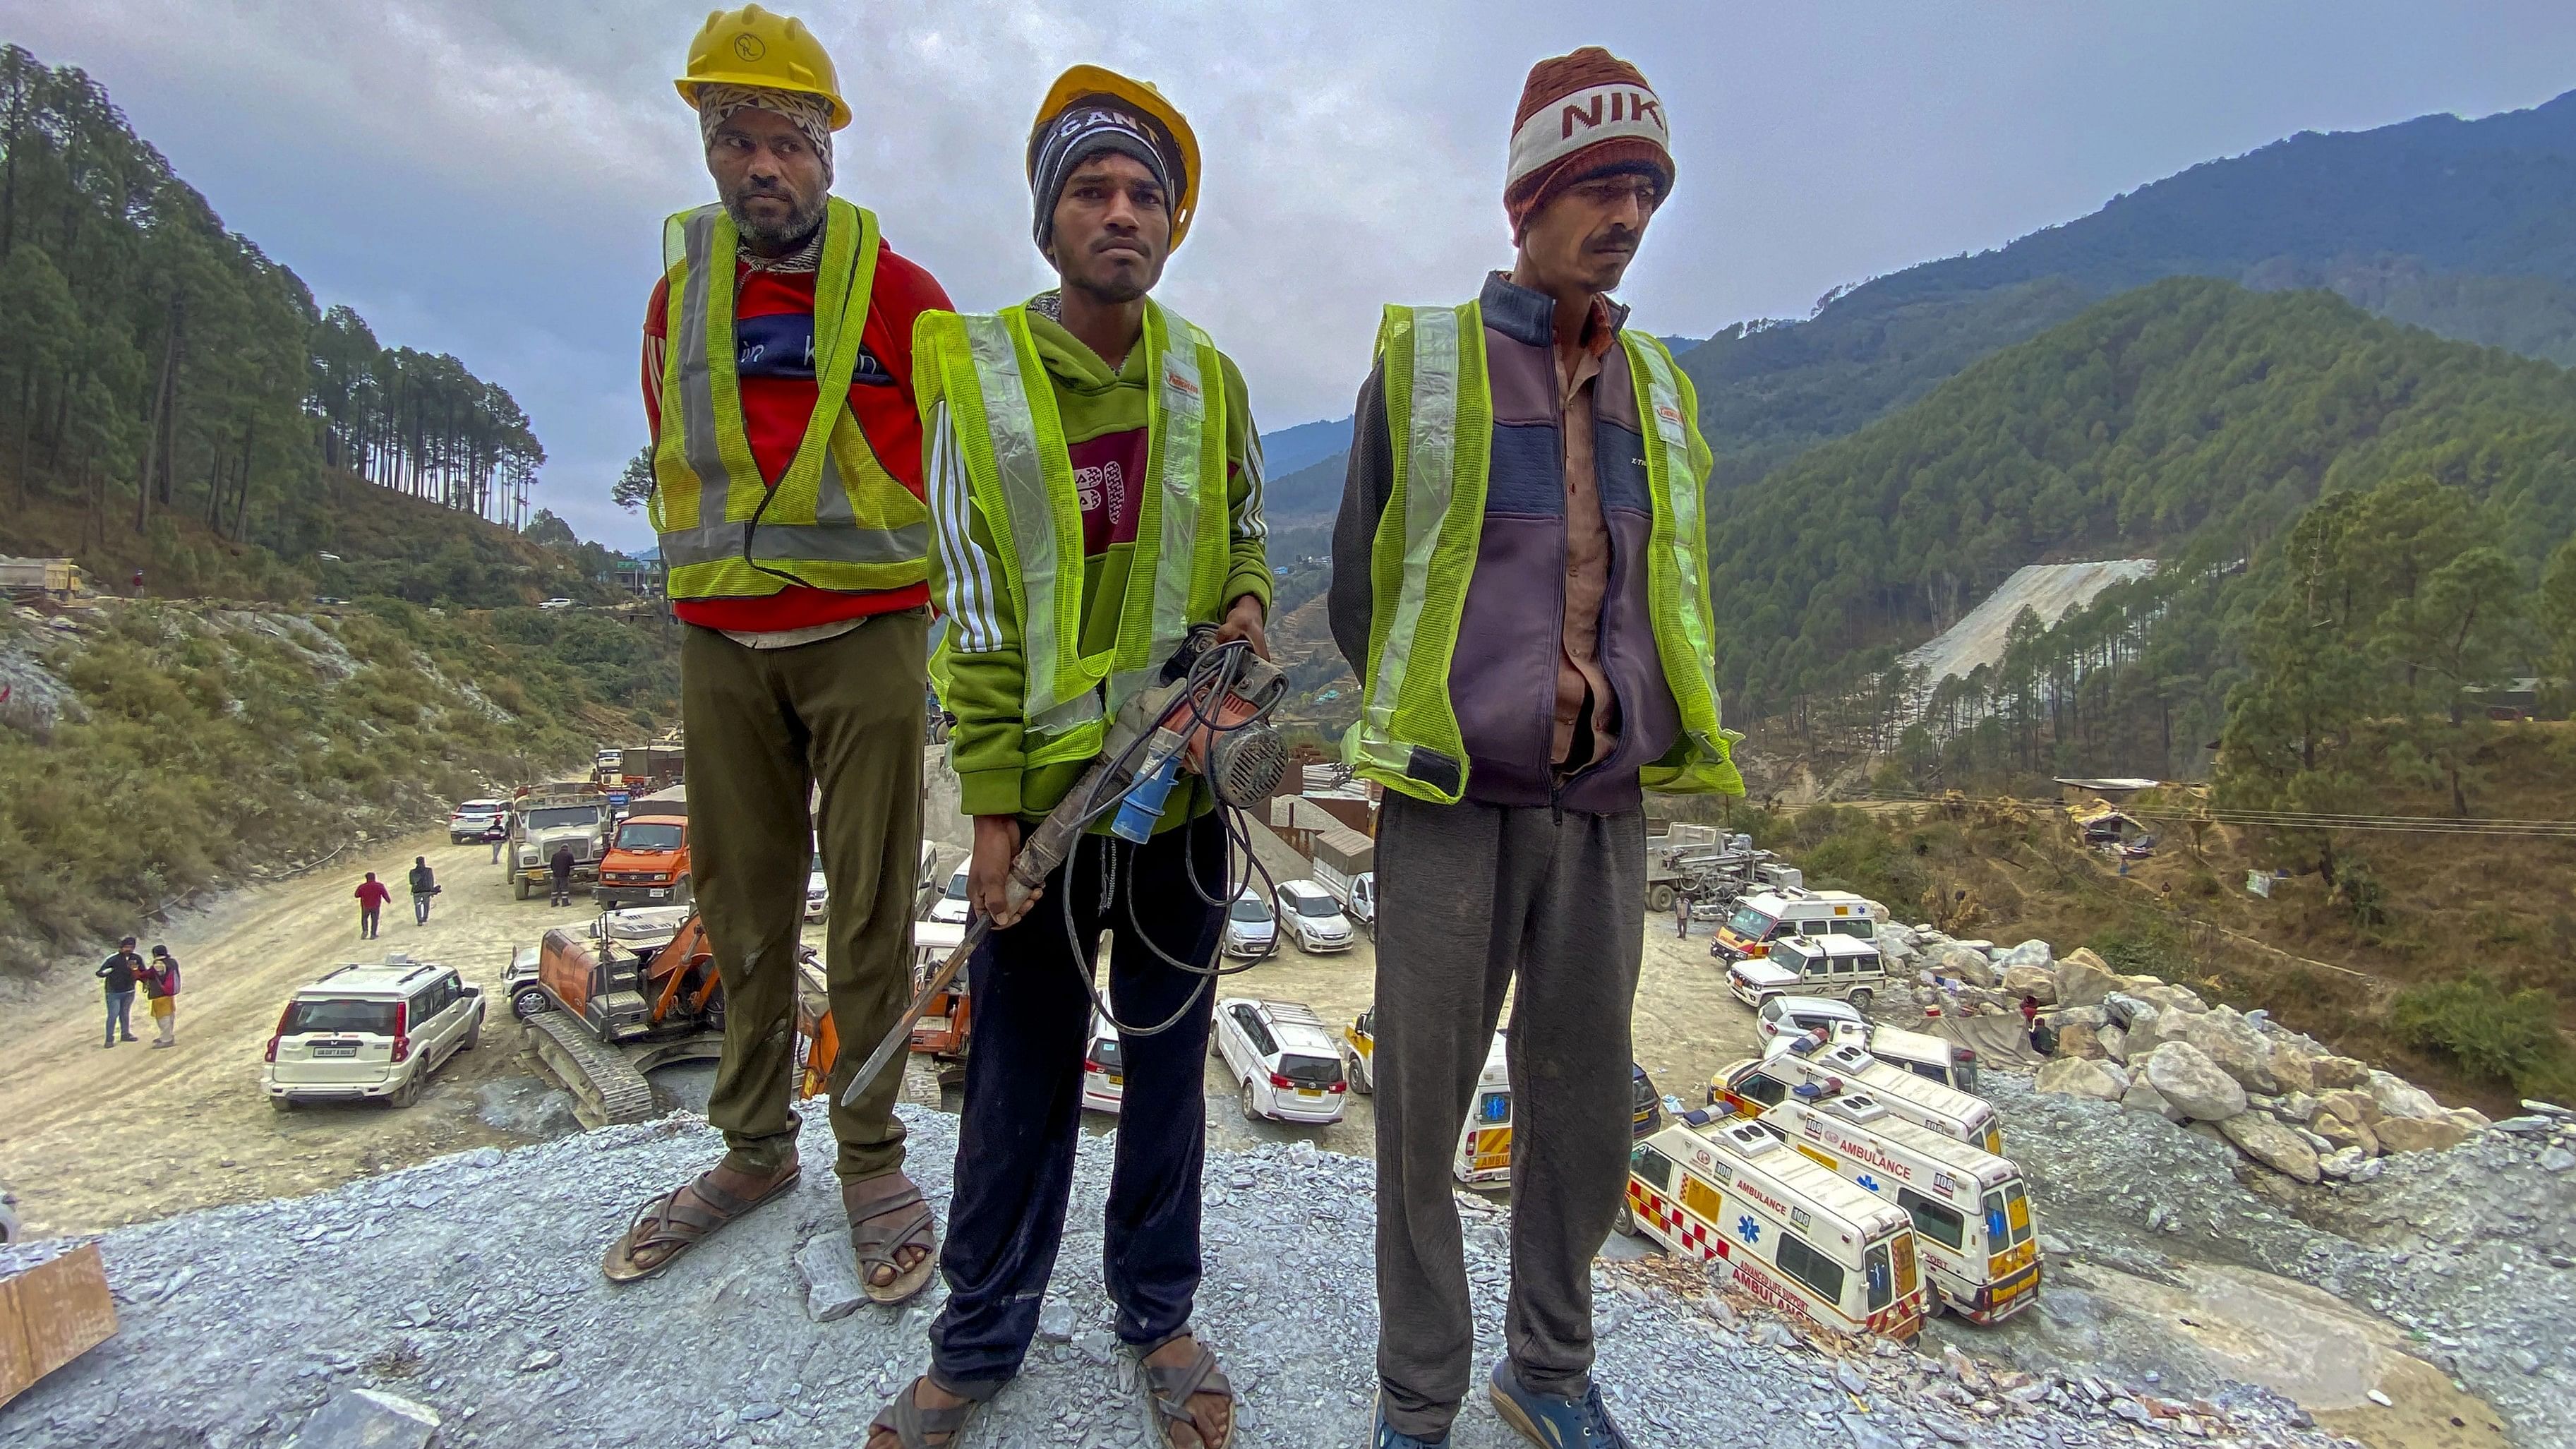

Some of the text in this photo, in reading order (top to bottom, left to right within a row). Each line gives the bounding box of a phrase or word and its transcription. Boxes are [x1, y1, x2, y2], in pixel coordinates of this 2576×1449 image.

[1807, 1119, 1822, 1134] 108
[1716, 1162, 1731, 1179] 108
[1839, 1140, 1911, 1181] AMBULANCE
[1936, 1174, 1954, 1191] 108
[1737, 1180, 1787, 1216] AMBULANCE
[1793, 1207, 1810, 1227] 108
[1740, 1261, 1809, 1312] ADVANCED LIFE SUPPORT
